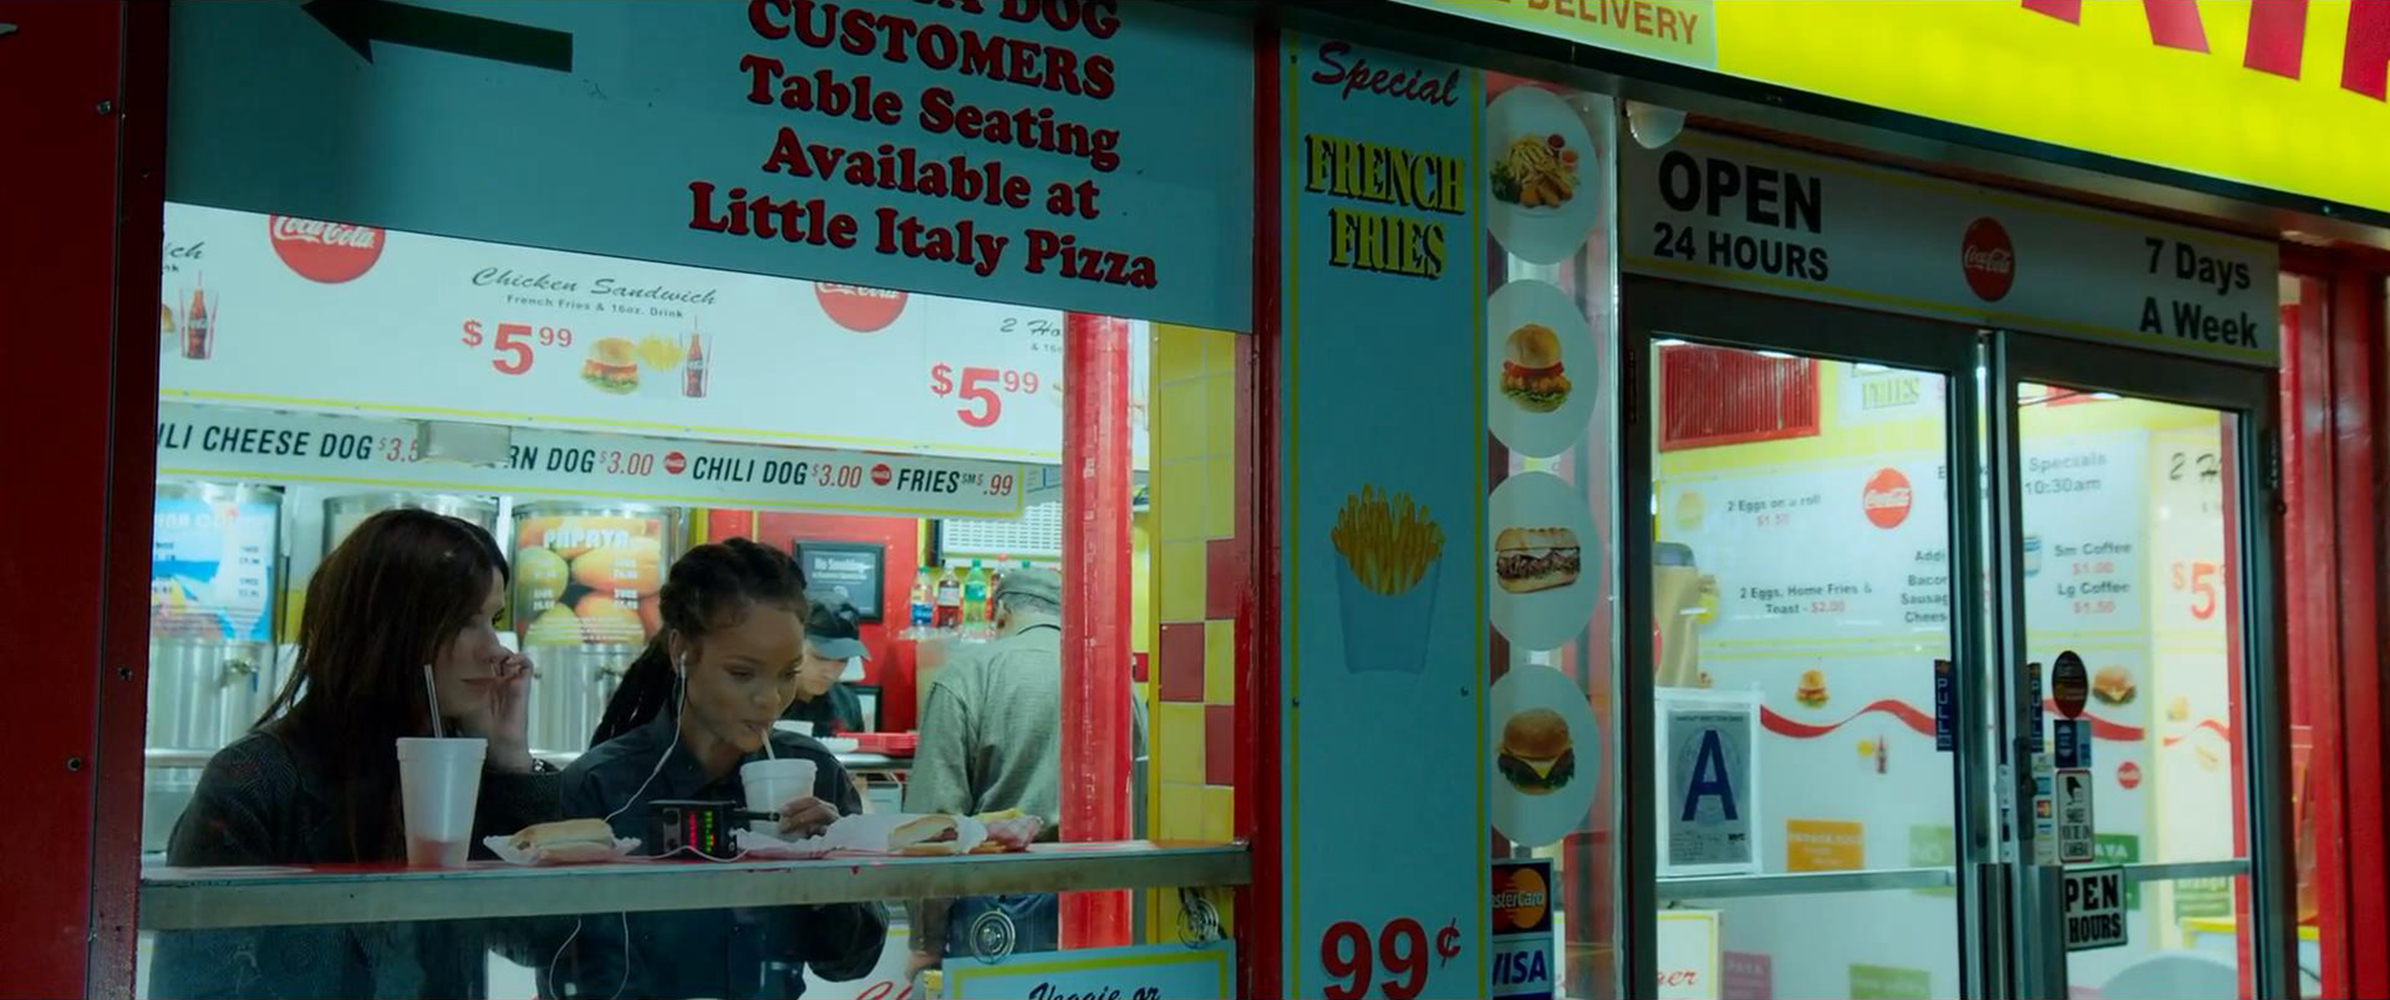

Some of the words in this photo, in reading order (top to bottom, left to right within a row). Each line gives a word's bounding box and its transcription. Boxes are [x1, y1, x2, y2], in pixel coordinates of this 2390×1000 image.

[1528, 0, 1698, 45] ELIVERY
[748, 0, 1116, 100] CUSTOMERS
[1312, 40, 1460, 107] Special
[740, 54, 903, 126] Table
[919, 86, 1120, 172] Seating
[763, 127, 1031, 209] Available
[1046, 180, 1100, 220] at
[1305, 133, 1466, 215] FRENCH
[1658, 150, 1823, 235] OPEN
[688, 182, 858, 250] Little
[876, 207, 1008, 277] Italy
[1025, 229, 1158, 290] Pizza
[1328, 206, 1447, 281] FRIES
[1653, 222, 1697, 262] 24
[1707, 230, 1830, 283] HOURS
[471, 267, 578, 293] Chicken
[590, 278, 718, 305] Sandwich
[2145, 236, 2165, 275] 7
[2175, 241, 2252, 297] Days
[506, 294, 554, 308] French
[557, 297, 591, 311] Fries
[649, 307, 684, 319] Drink
[2138, 296, 2164, 335] A
[2172, 299, 2259, 349] Week
[202, 425, 311, 457] CHEESE
[319, 432, 374, 460] DOG
[546, 447, 598, 474] DOG
[600, 449, 655, 477] $3.00
[2028, 453, 2108, 474] Specials
[692, 455, 755, 483] CHILI
[762, 460, 808, 486] DOG
[811, 463, 863, 488] $3.00
[897, 468, 961, 494] FRIES
[2082, 541, 2134, 556] Coffee
[2080, 580, 2131, 595] Coffee
[1681, 729, 1739, 822] A
[2069, 912, 2122, 943] HOURS
